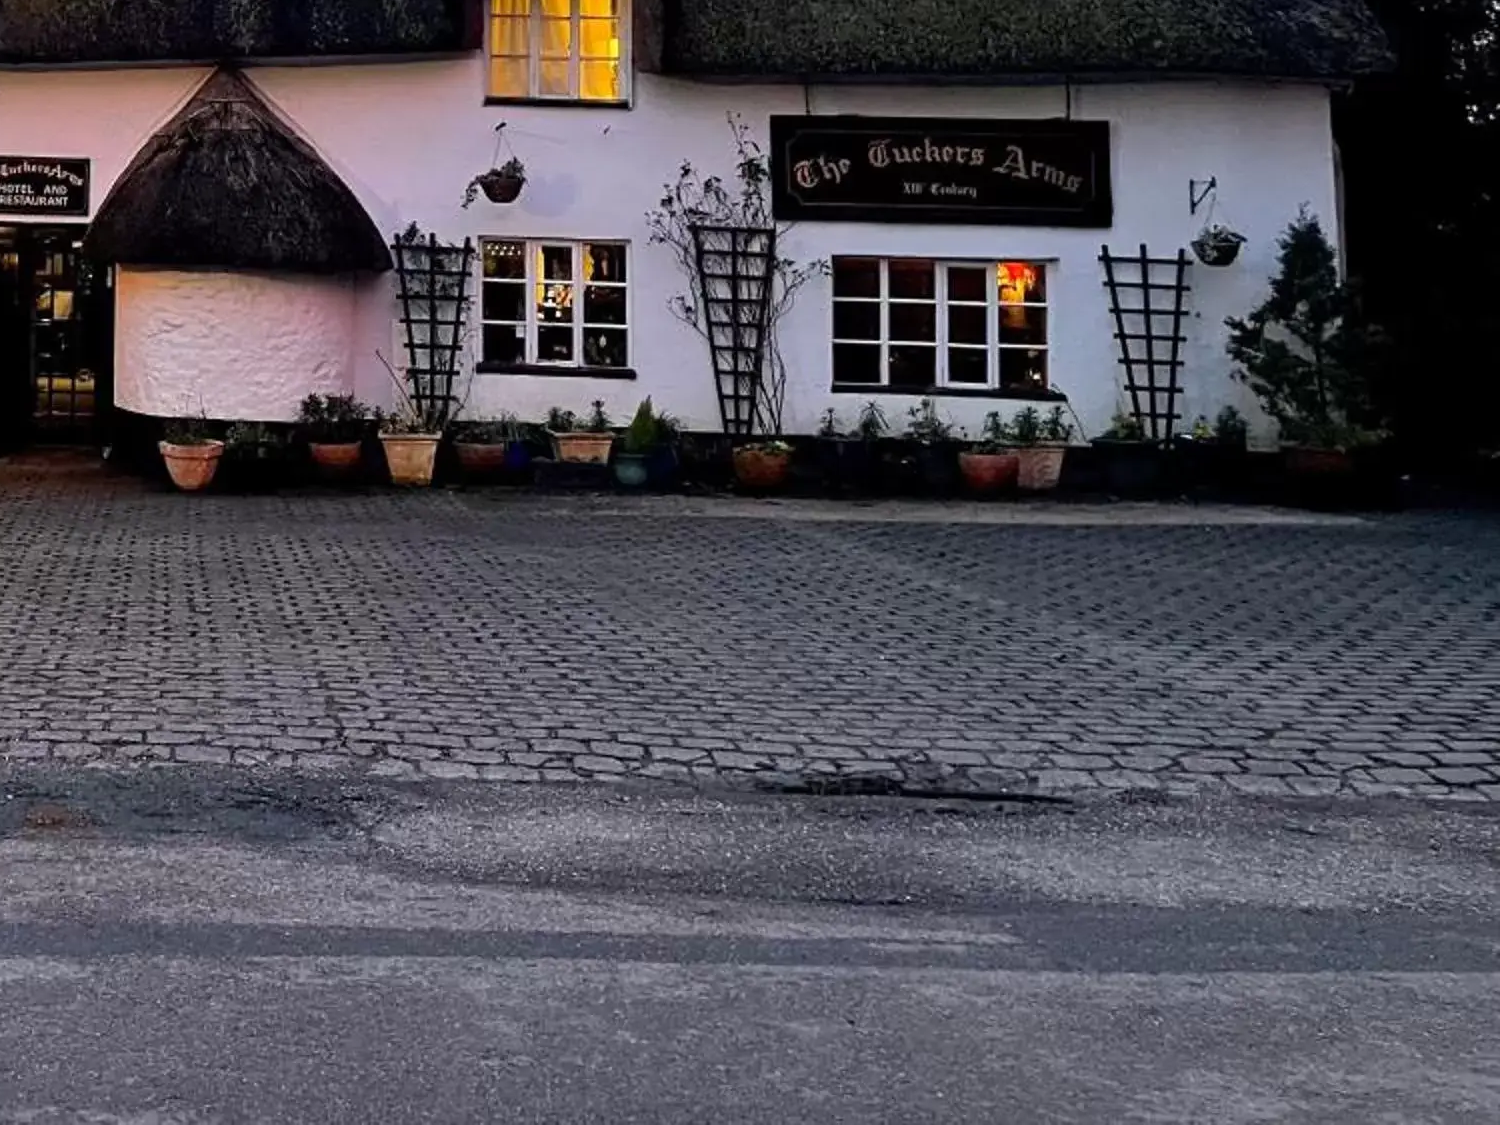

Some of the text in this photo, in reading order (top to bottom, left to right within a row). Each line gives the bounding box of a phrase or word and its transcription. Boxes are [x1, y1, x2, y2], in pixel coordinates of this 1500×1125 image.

[793, 137, 1084, 194] The Tuckers Arms
[43, 184, 69, 196] AND
